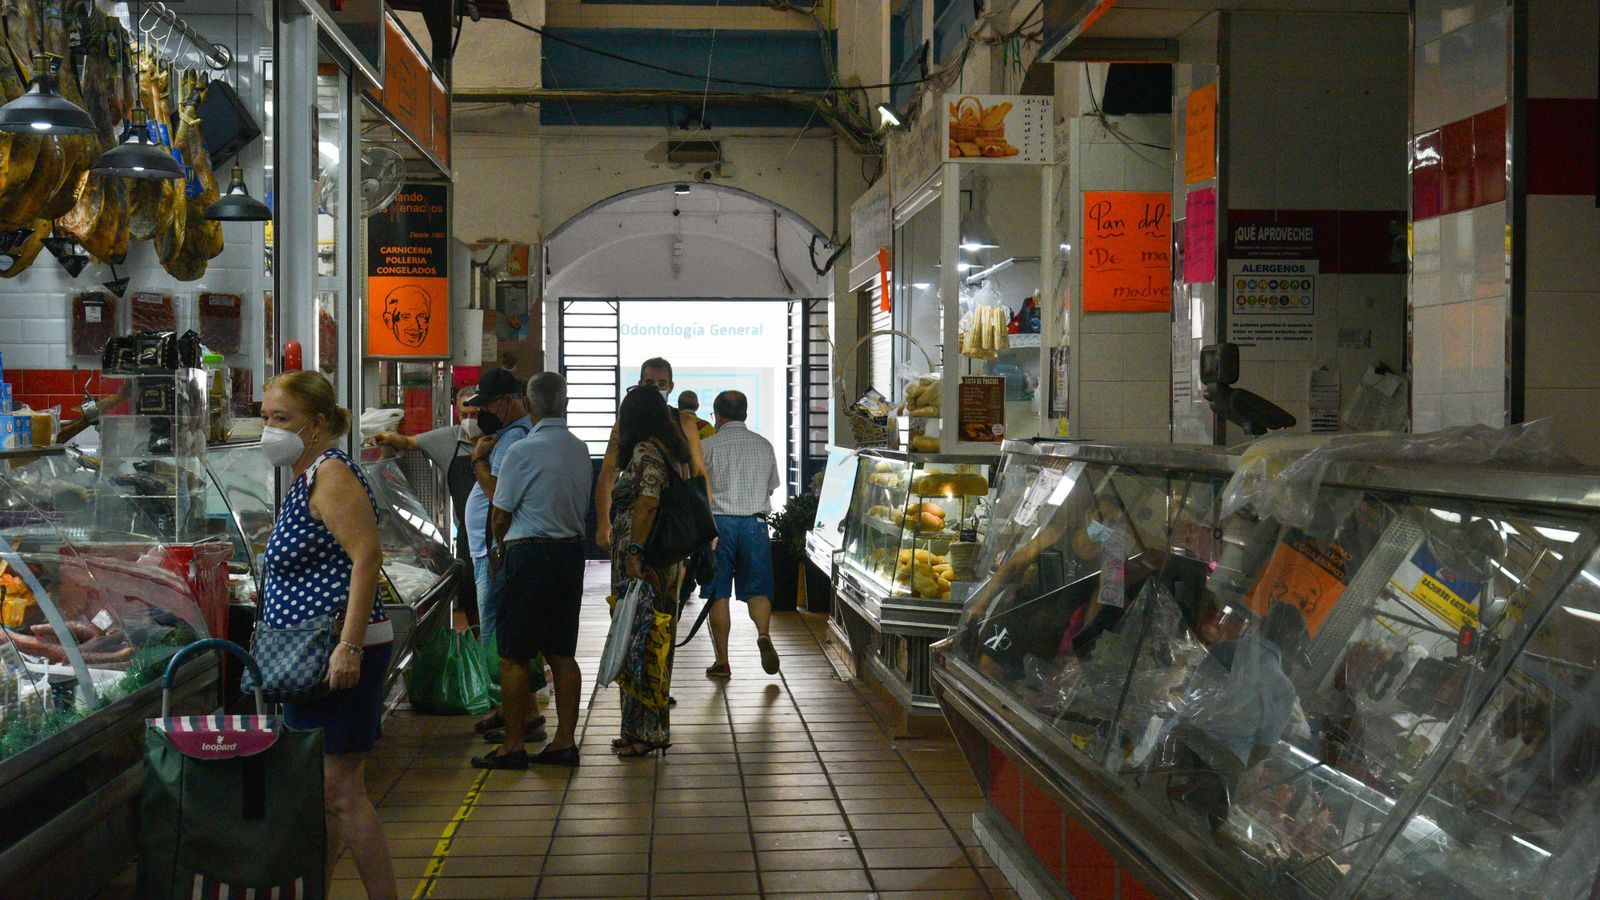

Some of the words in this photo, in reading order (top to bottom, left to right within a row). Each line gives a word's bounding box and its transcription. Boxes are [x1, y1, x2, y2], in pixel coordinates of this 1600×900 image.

[1088, 200, 1125, 231] Pan
[1257, 227, 1314, 241] APROVECHE!
[380, 246, 433, 254] CARNICERIA
[376, 266, 437, 275] CONGELADOS
[1241, 264, 1306, 273] ALERGENOS
[621, 322, 705, 339] Odontología
[710, 323, 763, 336] General
[201, 743, 237, 752] leopard
